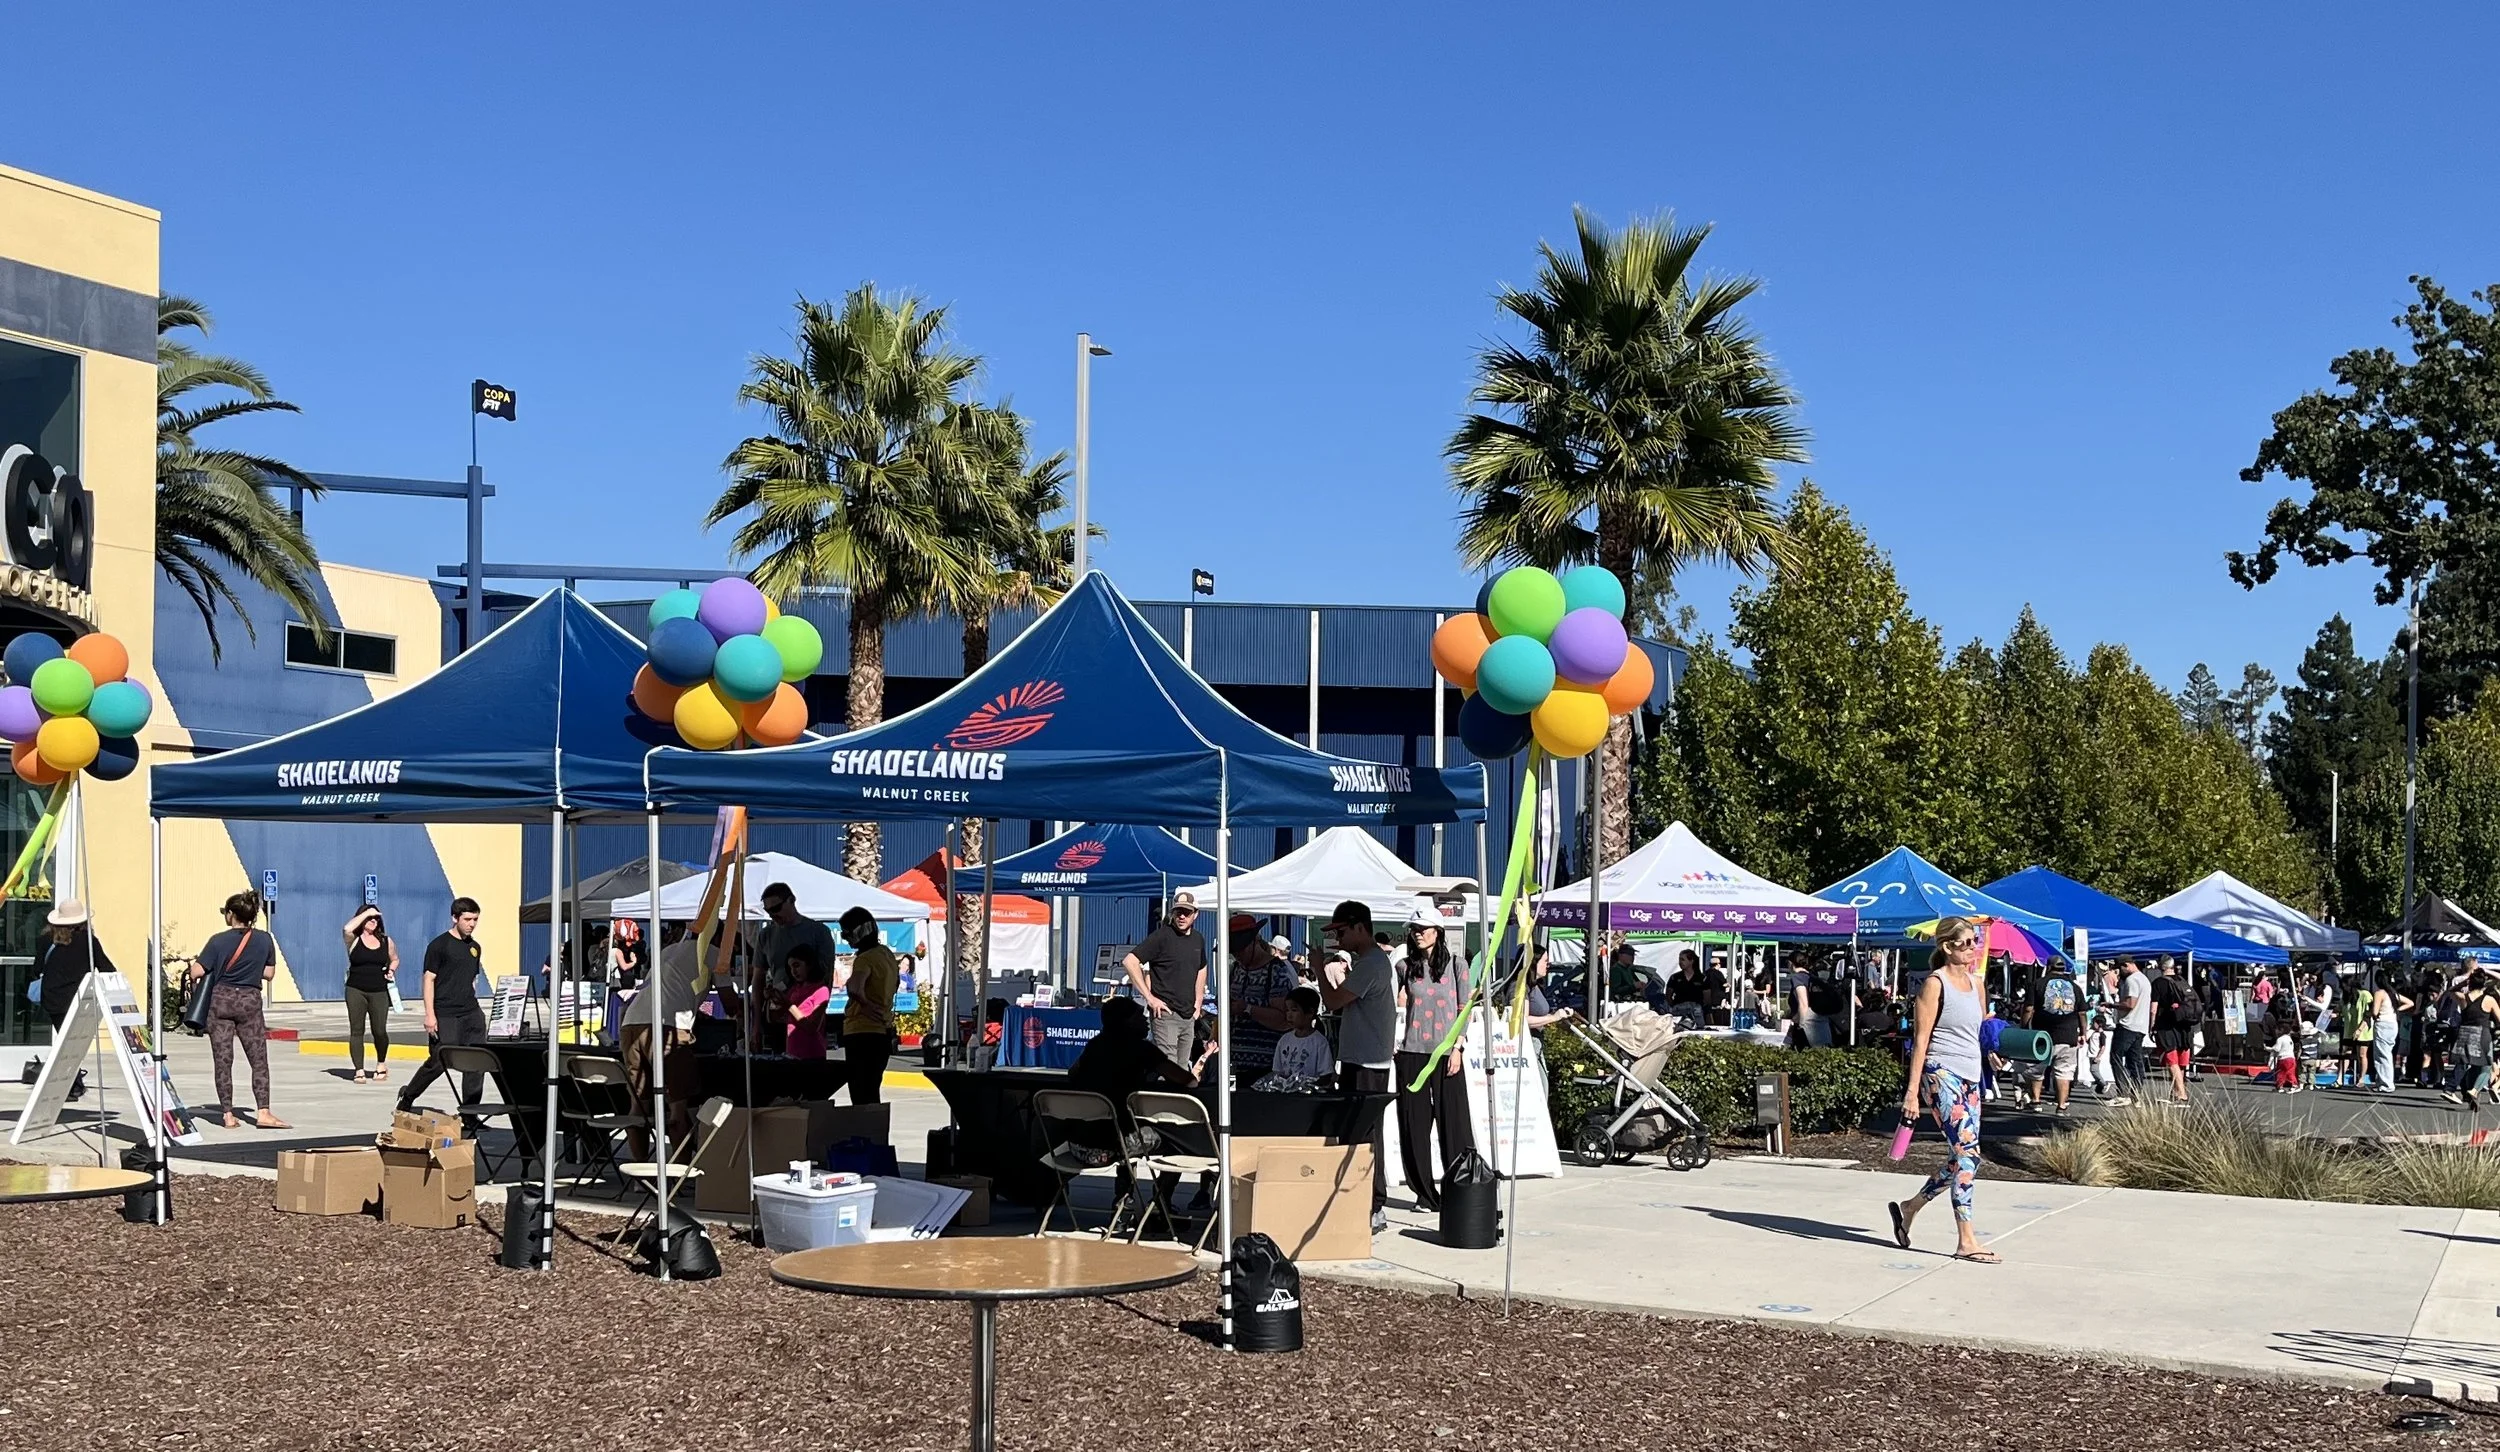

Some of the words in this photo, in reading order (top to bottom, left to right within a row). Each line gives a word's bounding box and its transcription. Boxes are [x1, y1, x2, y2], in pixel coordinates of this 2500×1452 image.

[483, 388, 511, 403] COPA
[831, 749, 1007, 781] SHADELANDS
[277, 760, 403, 788] SHADELANDS
[1329, 765, 1412, 793] SHADELANDS
[301, 794, 343, 805] WALNUT
[346, 792, 381, 804] CREEK
[862, 786, 918, 801] WALNUT
[923, 789, 970, 803] CREEK
[1347, 803, 1374, 814] WALNUT
[1021, 872, 1088, 884] SHADELANDS
[1629, 909, 1653, 923] UCSF
[1661, 909, 1685, 923] UCSF
[1692, 910, 1716, 924] UCSF
[1723, 910, 1747, 924] UCSF
[1755, 911, 1777, 924] UCSF
[1785, 911, 1808, 924] UCSF
[1816, 911, 1839, 925] UCSF
[1470, 1057, 1530, 1069] WIVER
